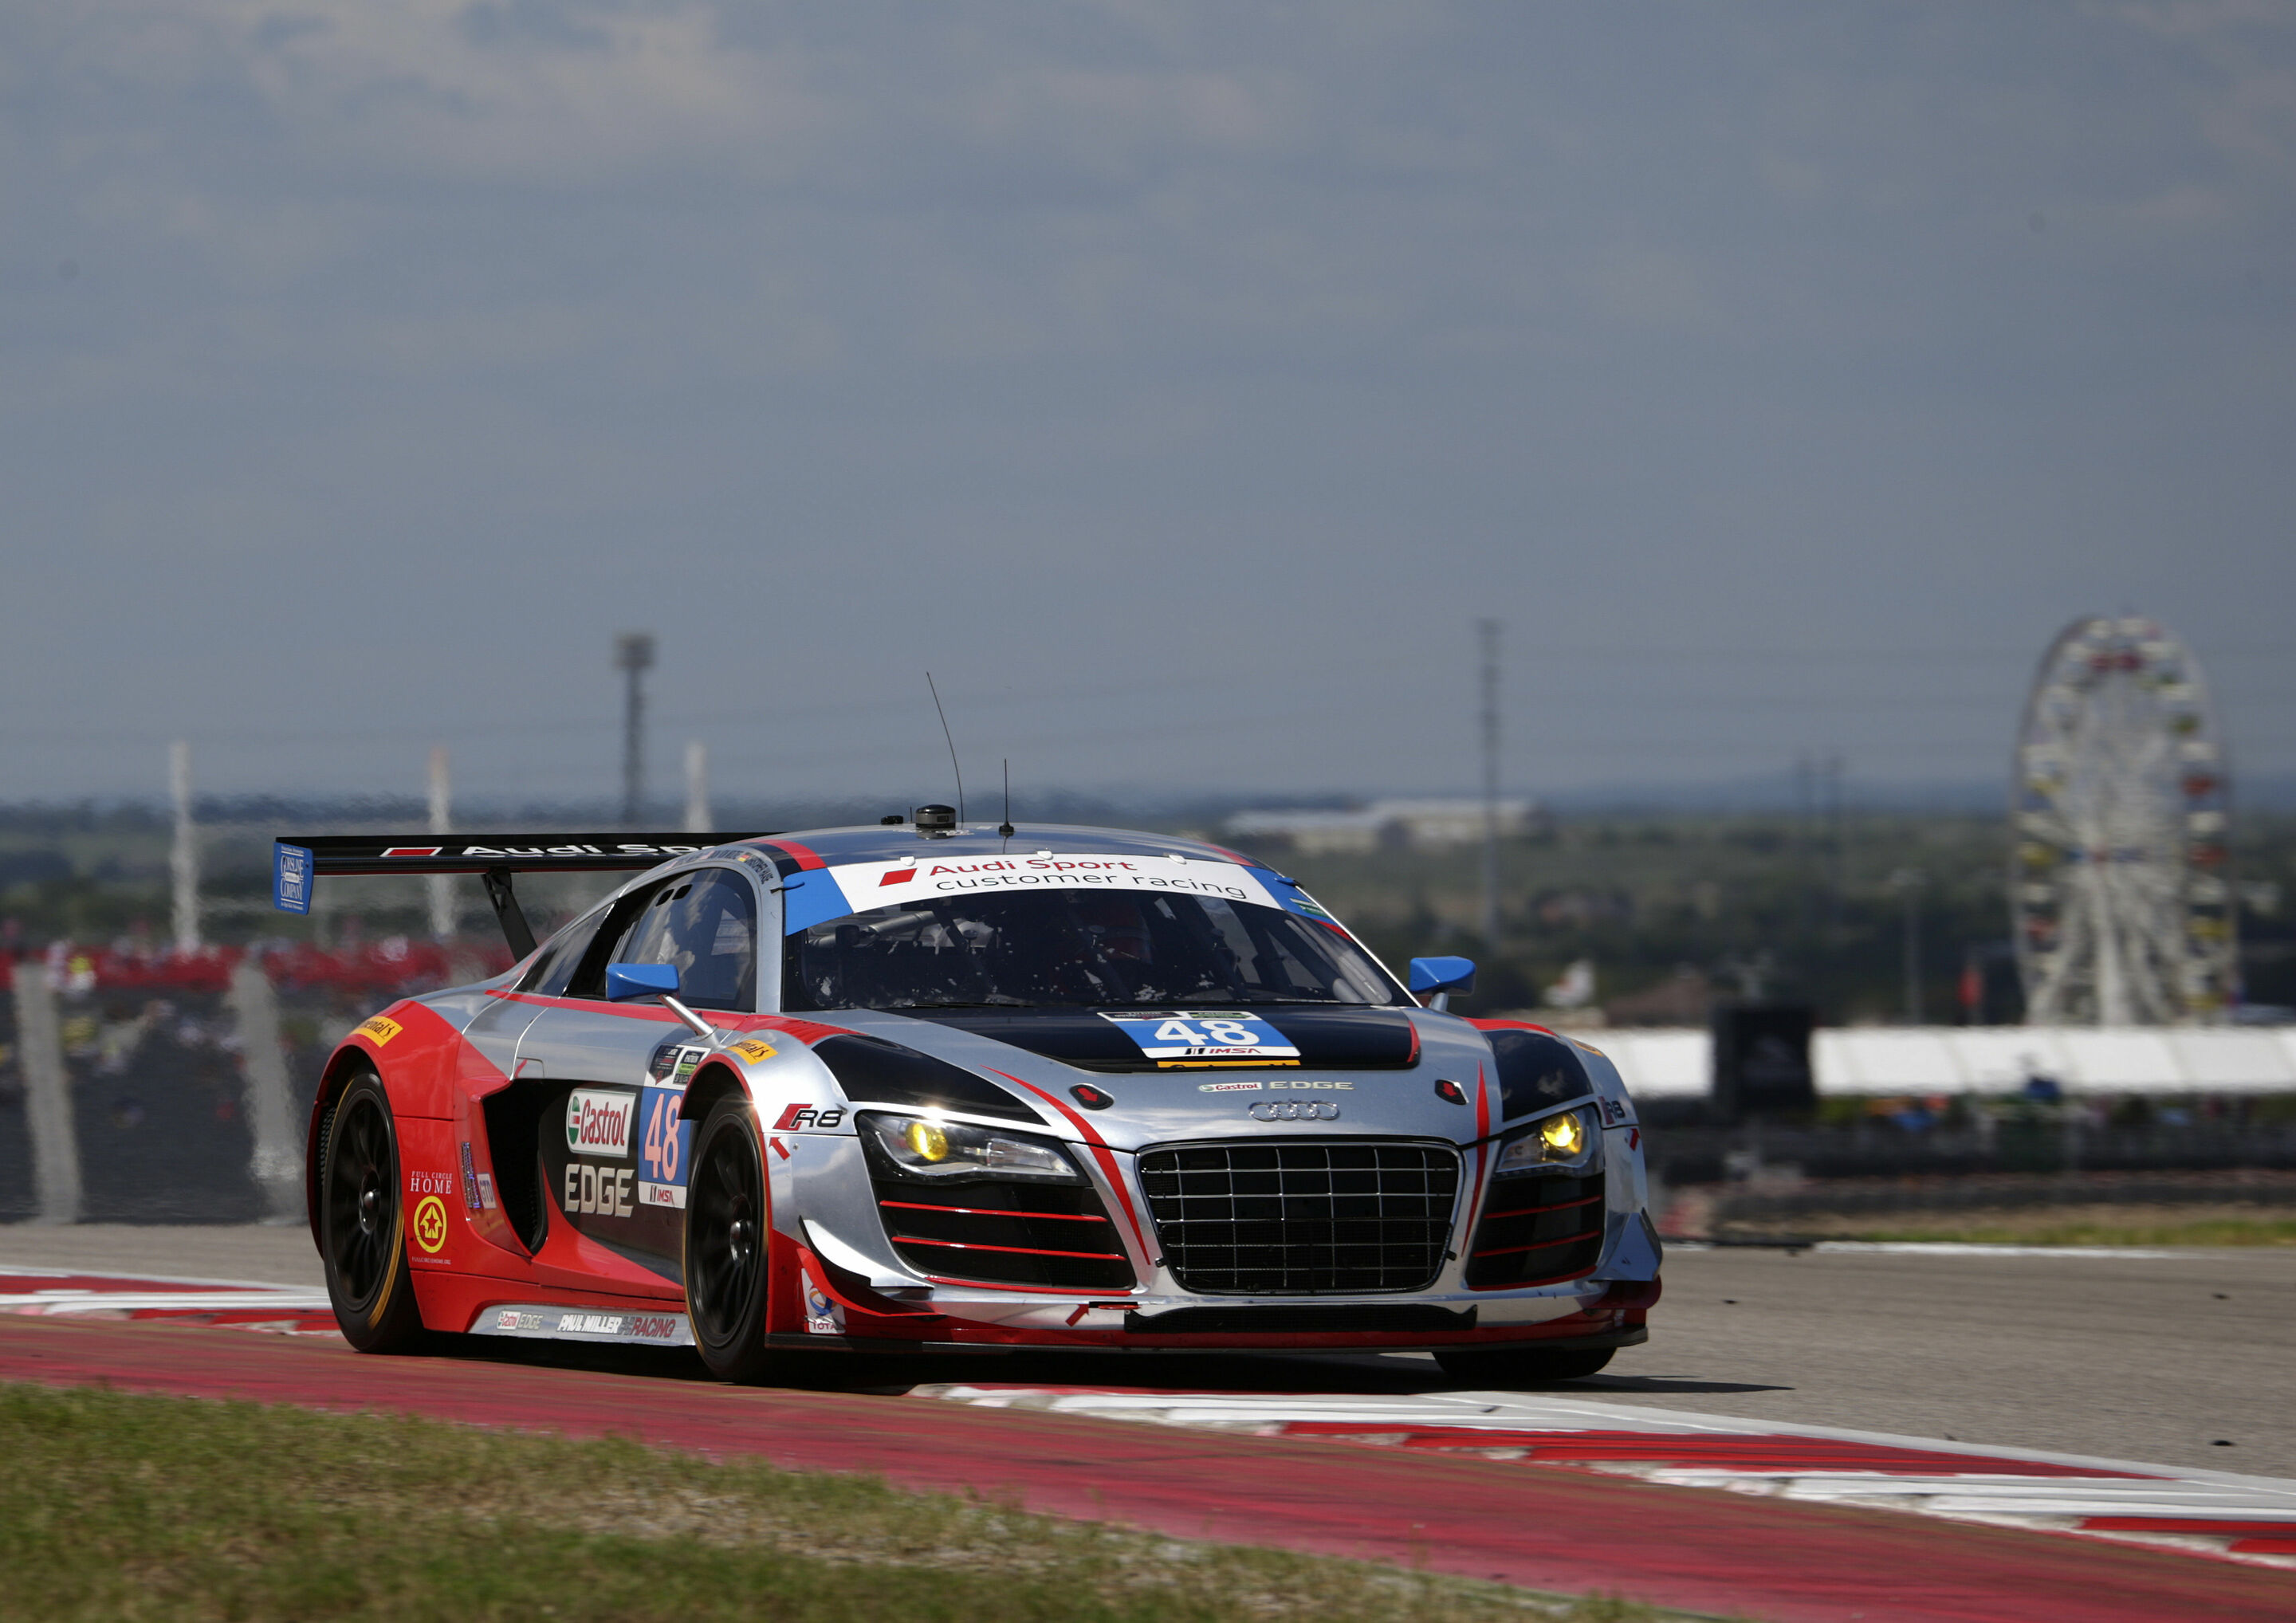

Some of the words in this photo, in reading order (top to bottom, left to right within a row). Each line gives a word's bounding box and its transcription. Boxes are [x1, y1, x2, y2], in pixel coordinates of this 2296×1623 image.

[462, 844, 604, 857] Audi
[930, 860, 1016, 876] Audi
[1026, 859, 1138, 871] Sport
[936, 874, 1118, 890] customer
[1132, 874, 1247, 899] racing
[1154, 1020, 1260, 1046] 48
[1215, 1083, 1259, 1091] Castrol
[1268, 1081, 1355, 1091] EDGE
[580, 1098, 628, 1147] Castrol
[789, 1109, 842, 1129] R8
[643, 1093, 682, 1182] 48
[411, 1170, 429, 1179] FULL
[410, 1177, 453, 1194] HOME
[564, 1163, 635, 1218] EDGE
[518, 1314, 544, 1330] EDGE
[582, 1315, 623, 1334] MILLER
[631, 1317, 676, 1338] RACING
